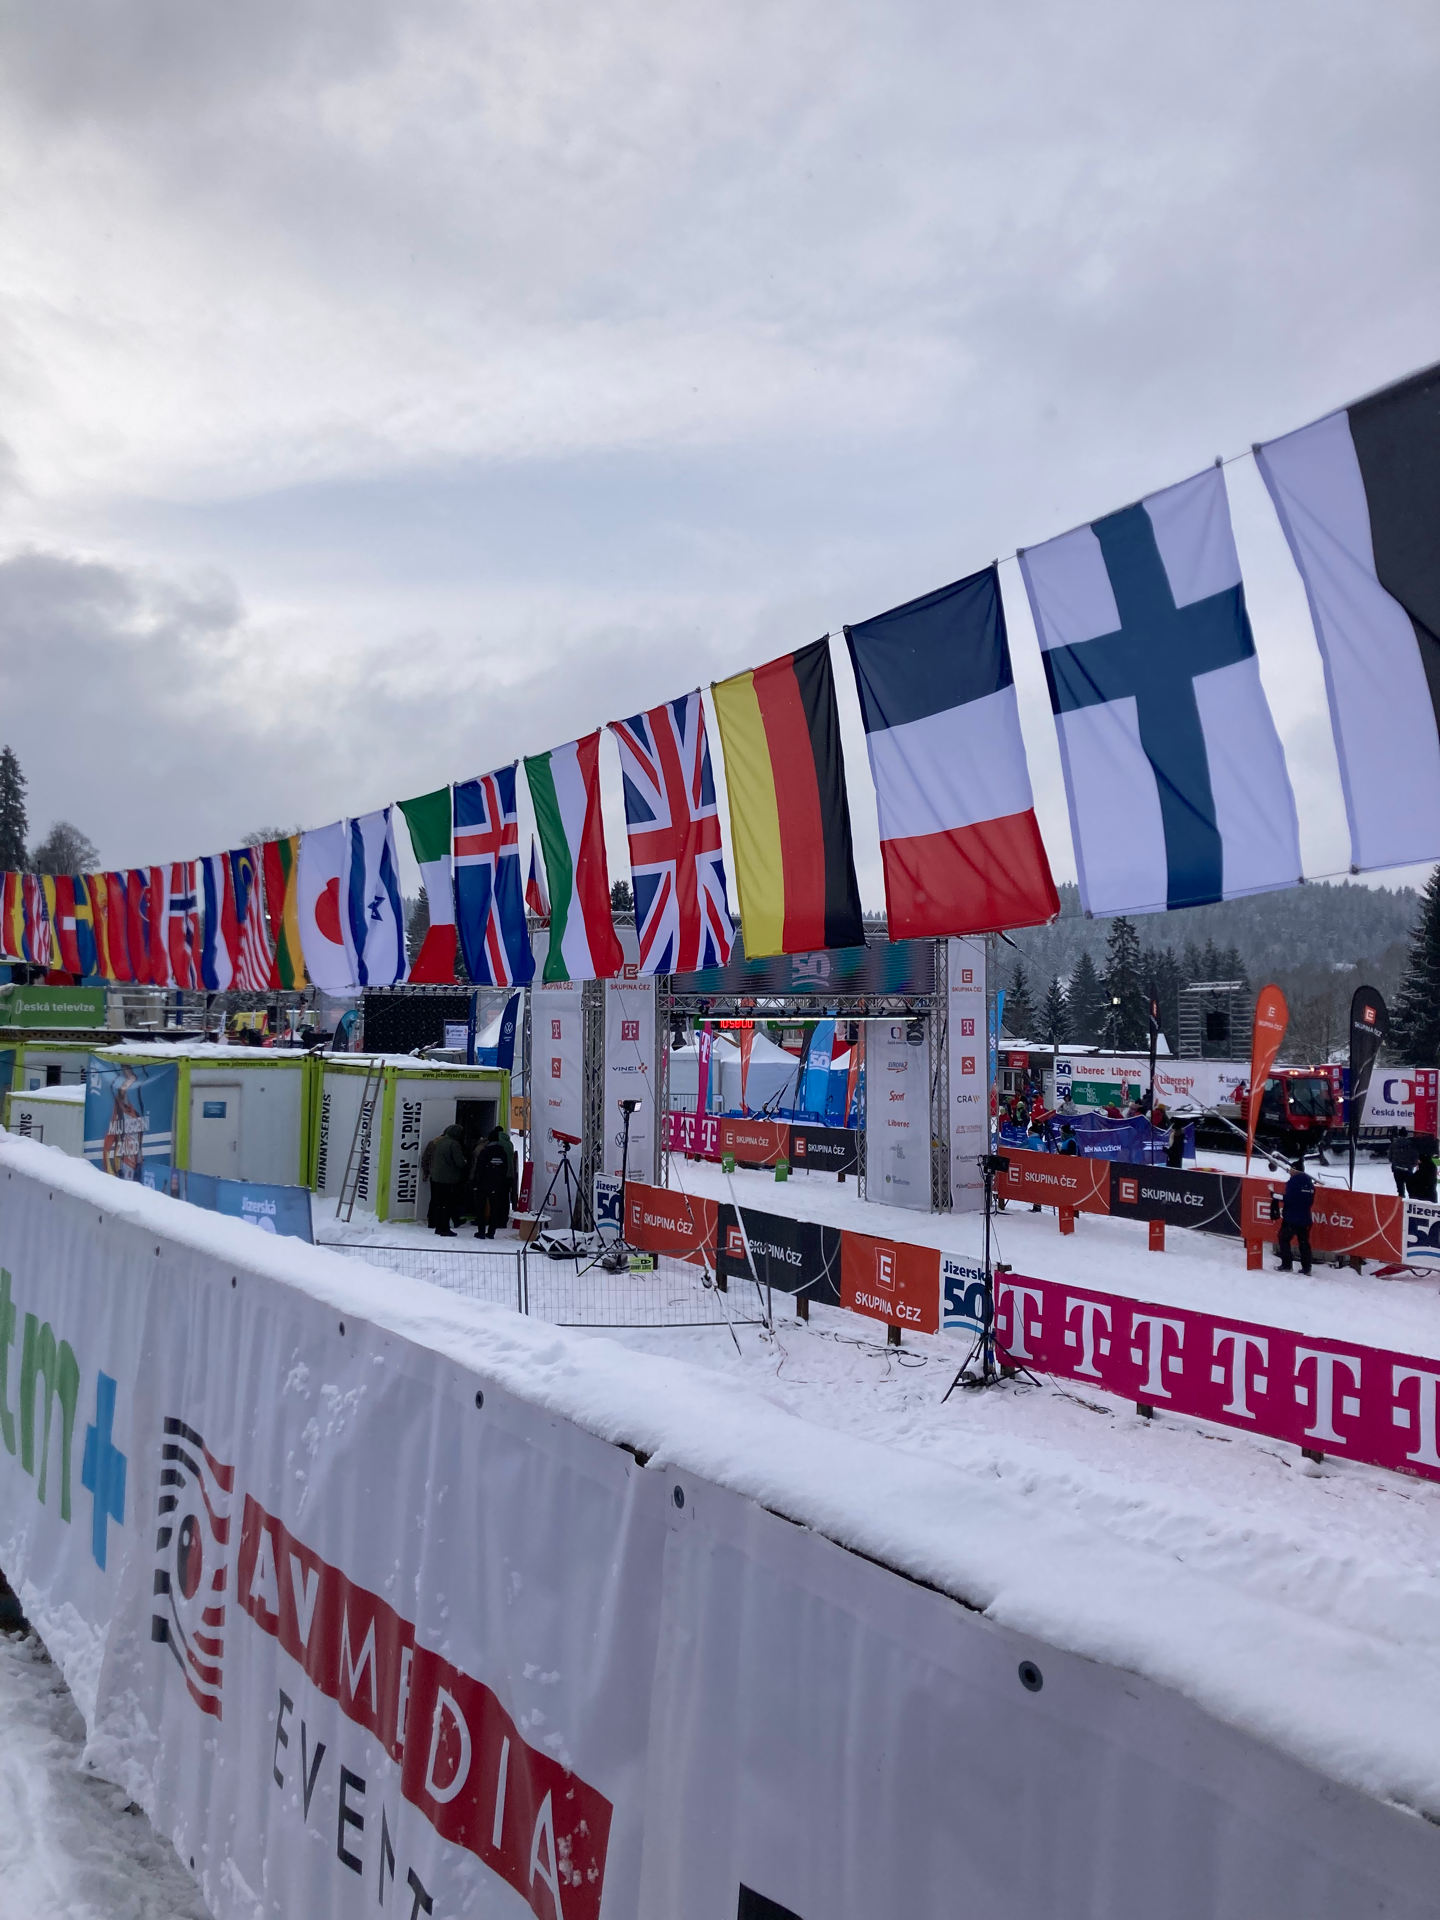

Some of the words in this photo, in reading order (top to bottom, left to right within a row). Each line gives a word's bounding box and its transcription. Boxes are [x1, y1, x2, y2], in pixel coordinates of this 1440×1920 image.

[638, 982, 651, 991] ČEZ
[52, 1002, 96, 1012] televize
[1056, 1064, 1072, 1075] 50
[1076, 1066, 1105, 1075] Liberec
[1112, 1068, 1142, 1077] Liberec
[1160, 1075, 1194, 1088] Liberecký
[1174, 1085, 1188, 1096] kraj
[1371, 1106, 1395, 1116] Česká
[888, 1118, 910, 1128] Liberec
[318, 1093, 332, 1190] JOHNNYSERVIS
[736, 1136, 758, 1146] SKUPINA
[758, 1136, 769, 1147] ČEZ
[808, 1144, 833, 1154] SKUPINA
[833, 1145, 845, 1156] ČEZ
[1024, 1172, 1059, 1186] SKUPINA
[1060, 1174, 1078, 1188] ČEZ
[1141, 1188, 1182, 1204] SKUPINA
[1183, 1192, 1204, 1207] ČEZ
[241, 1196, 276, 1216] Jizerská
[643, 1212, 676, 1232] SKUPINA
[676, 1218, 694, 1236] ČEZ
[1330, 1212, 1354, 1228] ČEZ
[786, 1246, 803, 1266] ČEZ
[943, 1260, 988, 1282] Jizersk
[854, 1291, 894, 1316] SKUPINA
[896, 1301, 922, 1322] ČEZ
[249, 1525, 565, 1920] AVMEDIA
